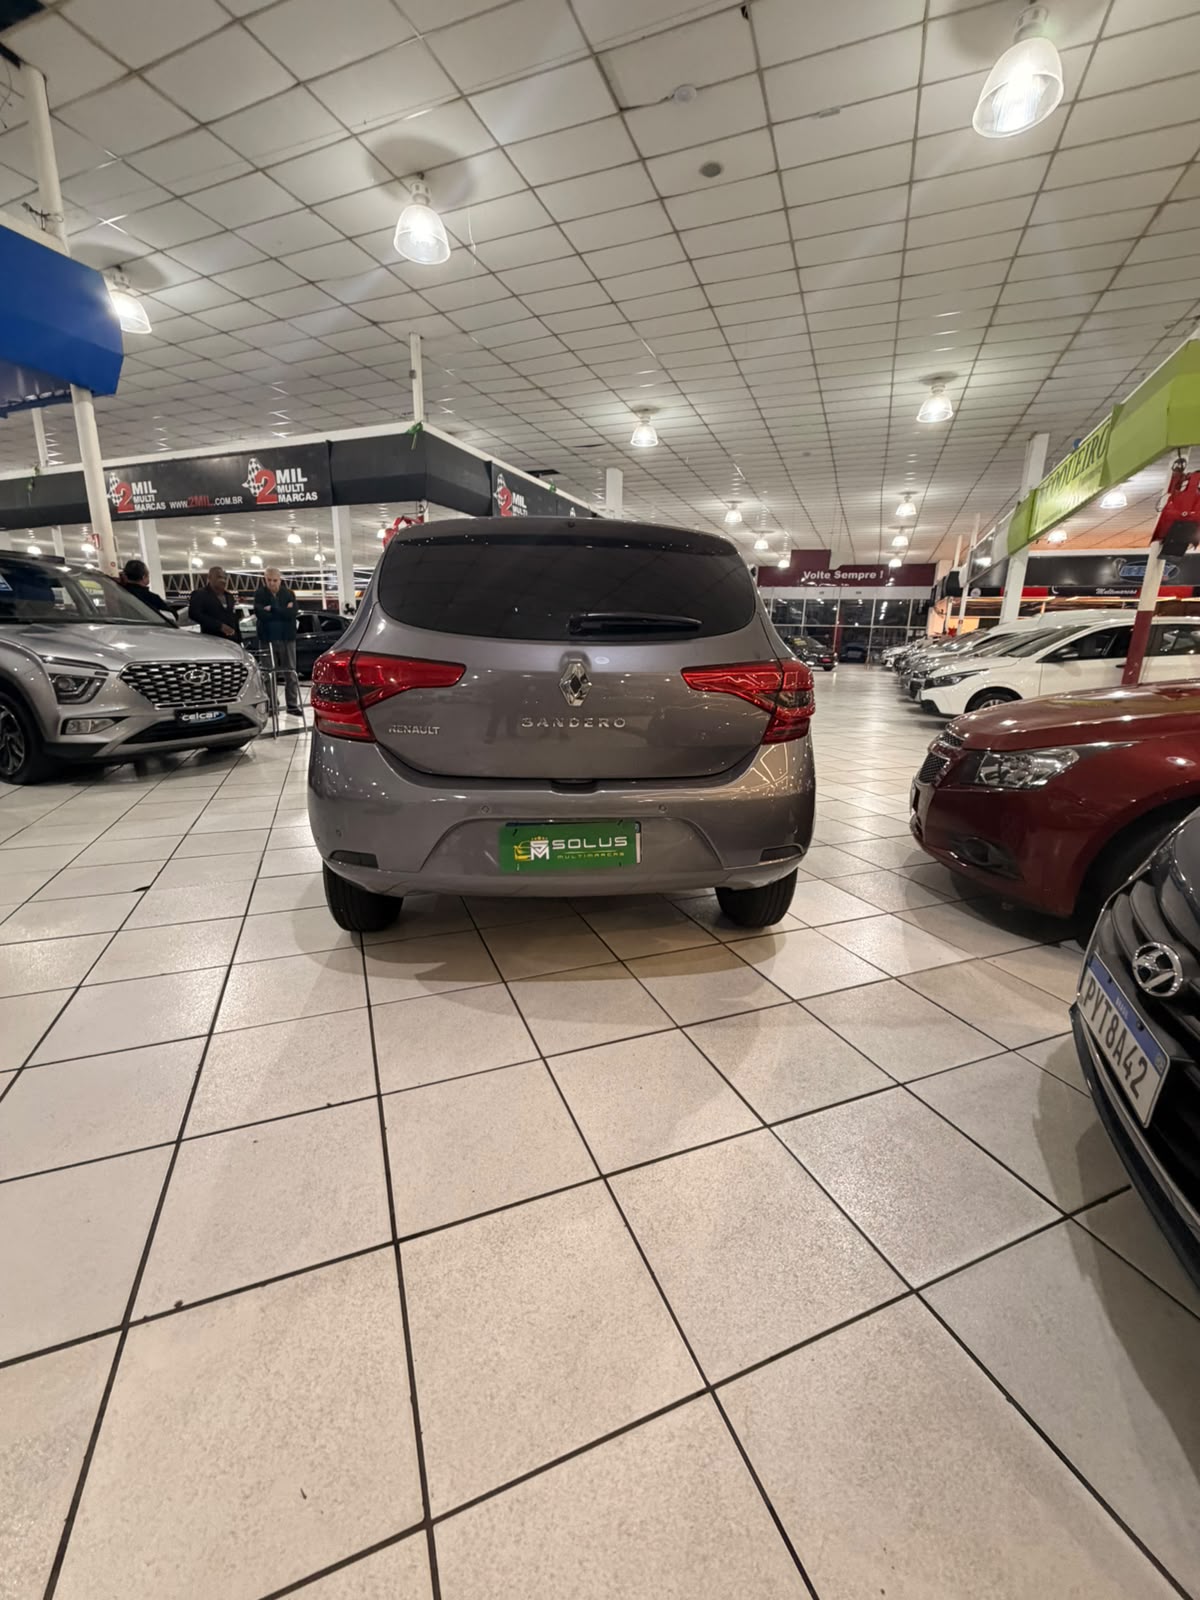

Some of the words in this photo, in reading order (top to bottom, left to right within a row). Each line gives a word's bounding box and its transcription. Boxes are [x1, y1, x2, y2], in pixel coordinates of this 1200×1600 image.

[255, 469, 276, 504] 2
[275, 467, 308, 484] MIL
[277, 483, 304, 494] MULTI
[115, 482, 135, 513] 2
[131, 480, 157, 495] MIL
[133, 495, 155, 503] MULTI
[278, 491, 318, 503] MARCAS
[512, 492, 527, 508] MIL
[134, 502, 166, 511] MARCAS
[803, 570, 831, 580] Volte
[834, 570, 877, 581] Sempre
[521, 717, 626, 728] SANDERO
[388, 724, 440, 735] RENAULT
[552, 836, 628, 850] SOLUS
[1083, 978, 1148, 1099] PYT8A42
